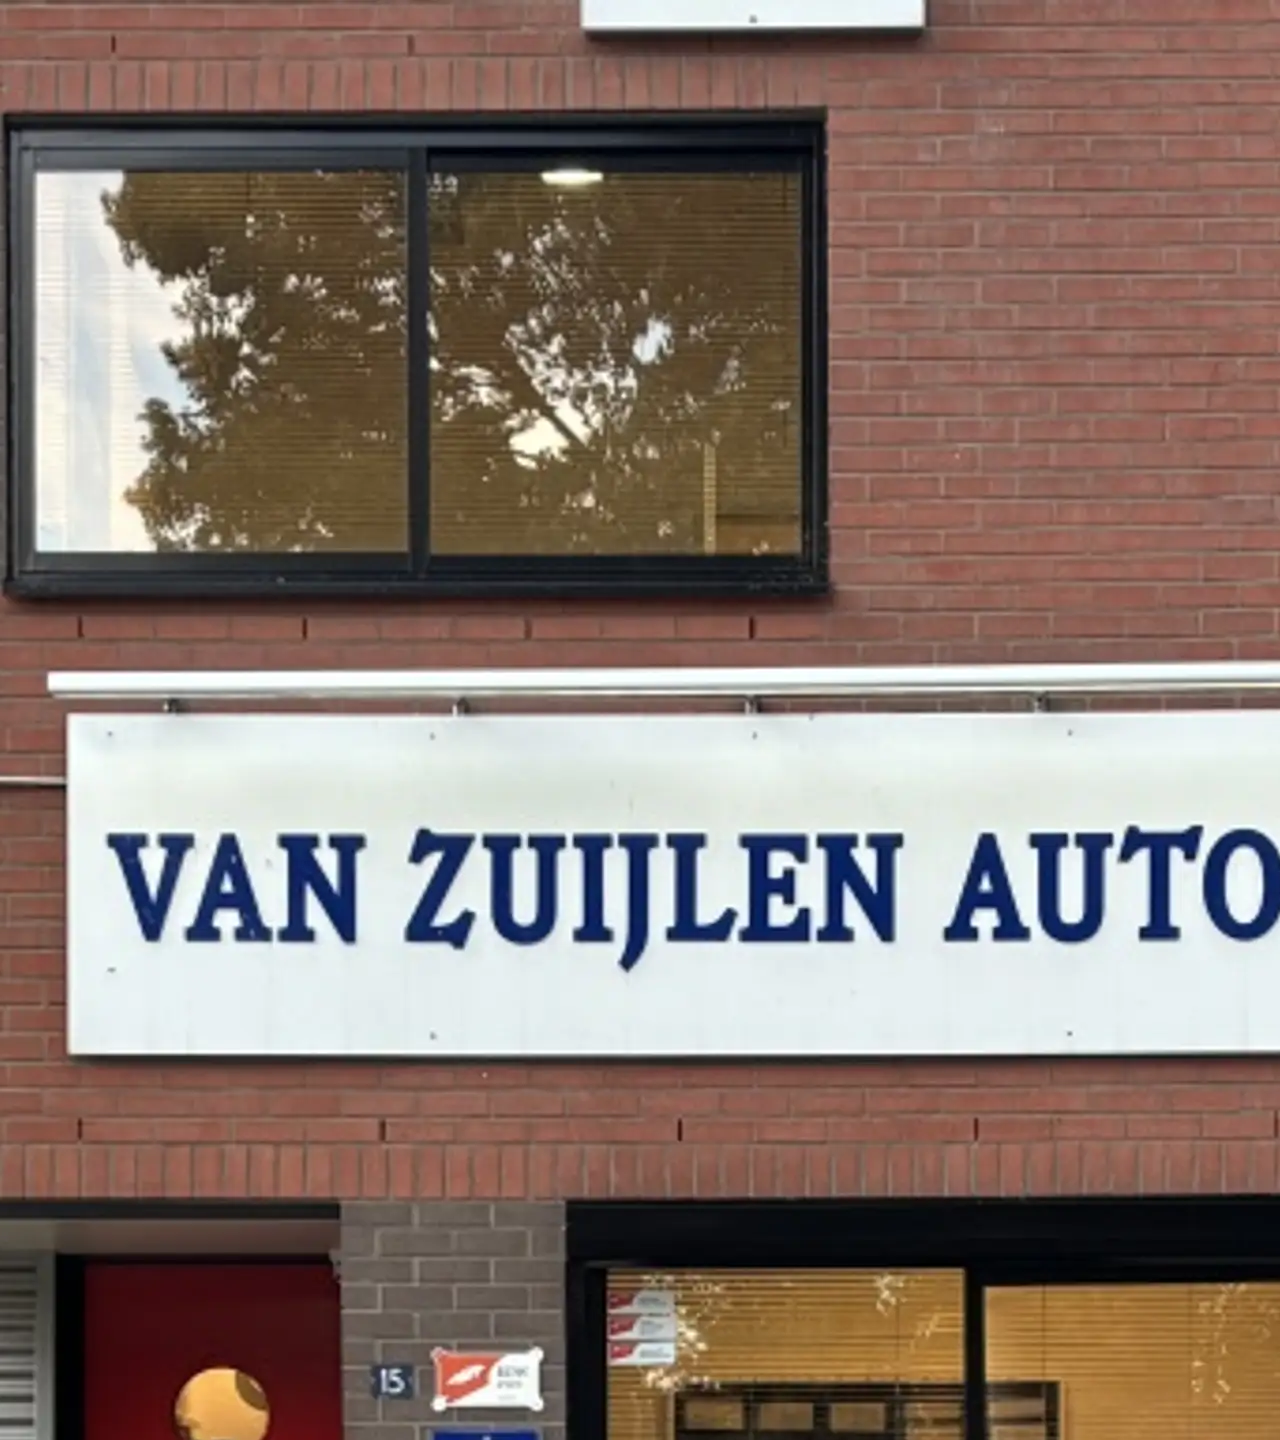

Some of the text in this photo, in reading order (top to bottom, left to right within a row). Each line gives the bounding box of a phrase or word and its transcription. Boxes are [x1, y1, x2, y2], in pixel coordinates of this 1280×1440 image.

[106, 833, 367, 945] VAN
[404, 828, 904, 973] ZUIJLEN
[380, 1367, 406, 1394] 15
